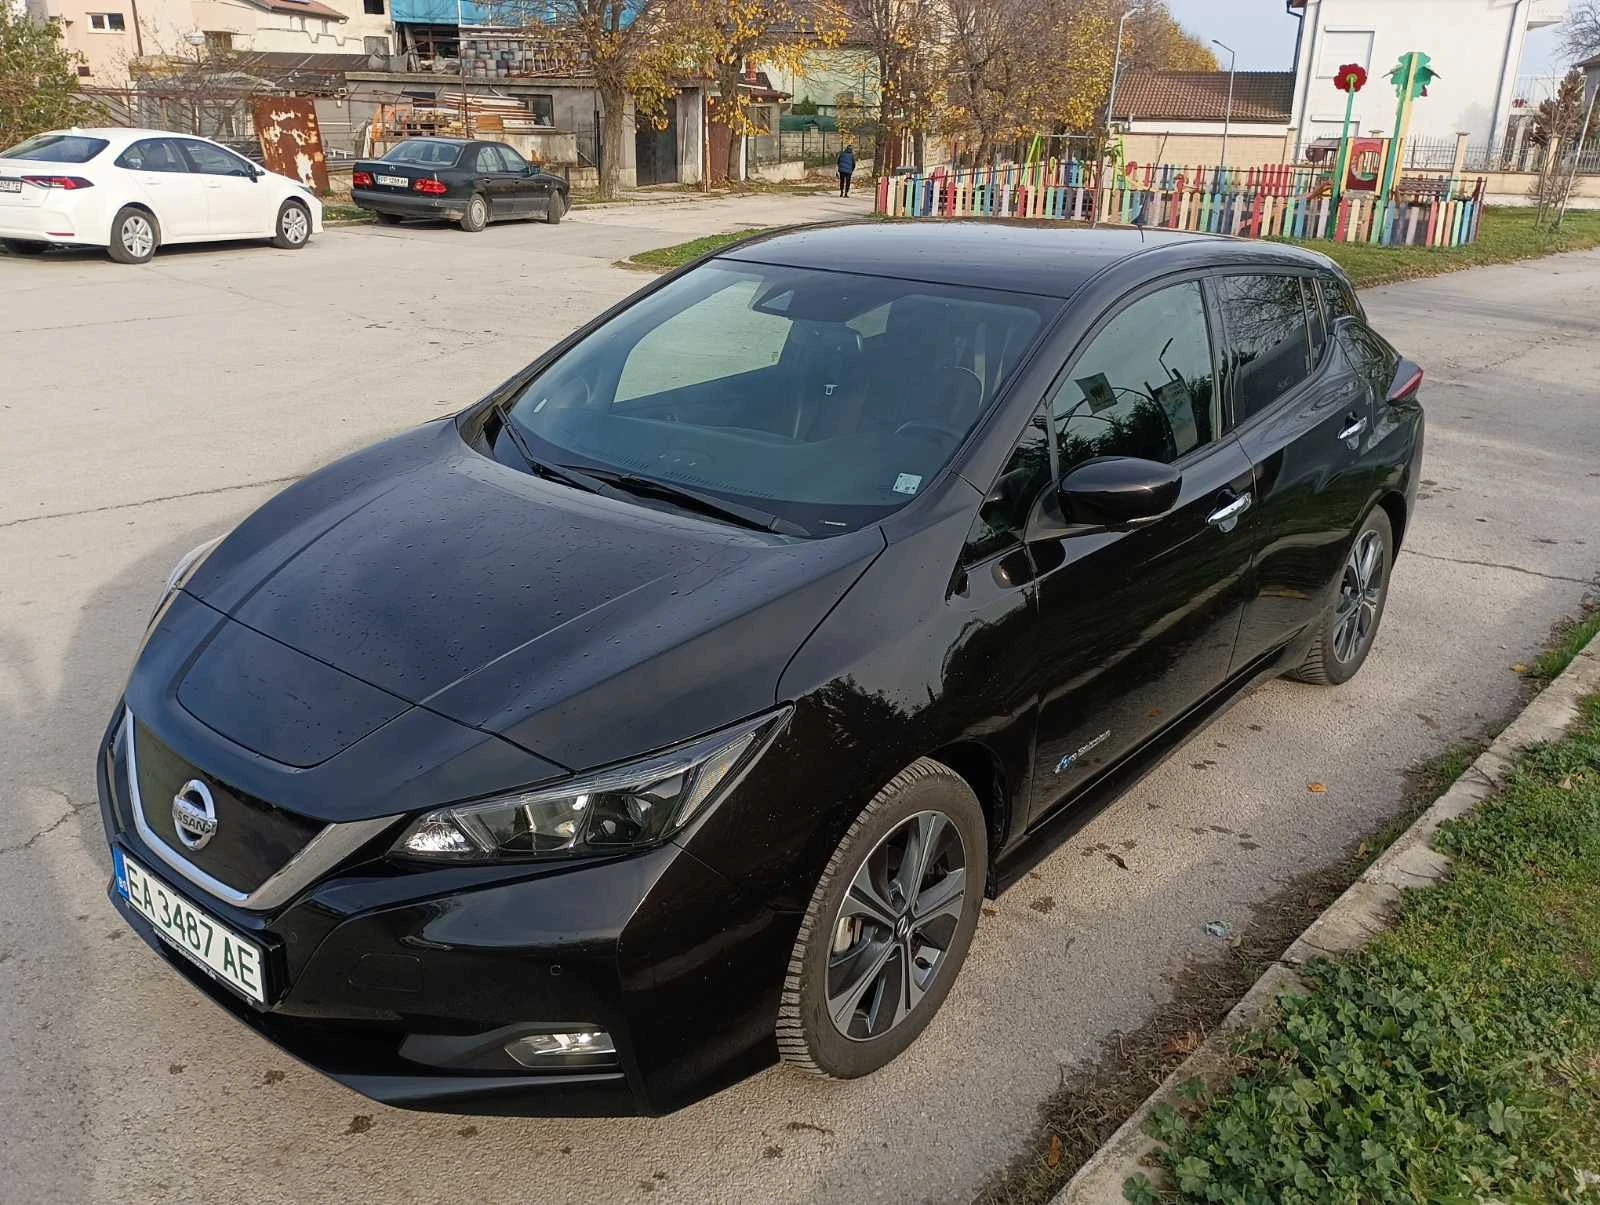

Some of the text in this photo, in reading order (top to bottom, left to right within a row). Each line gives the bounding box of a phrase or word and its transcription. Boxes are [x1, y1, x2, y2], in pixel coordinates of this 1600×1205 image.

[127, 864, 157, 918] EA
[158, 892, 214, 958] 3487
[224, 937, 257, 992] AE
